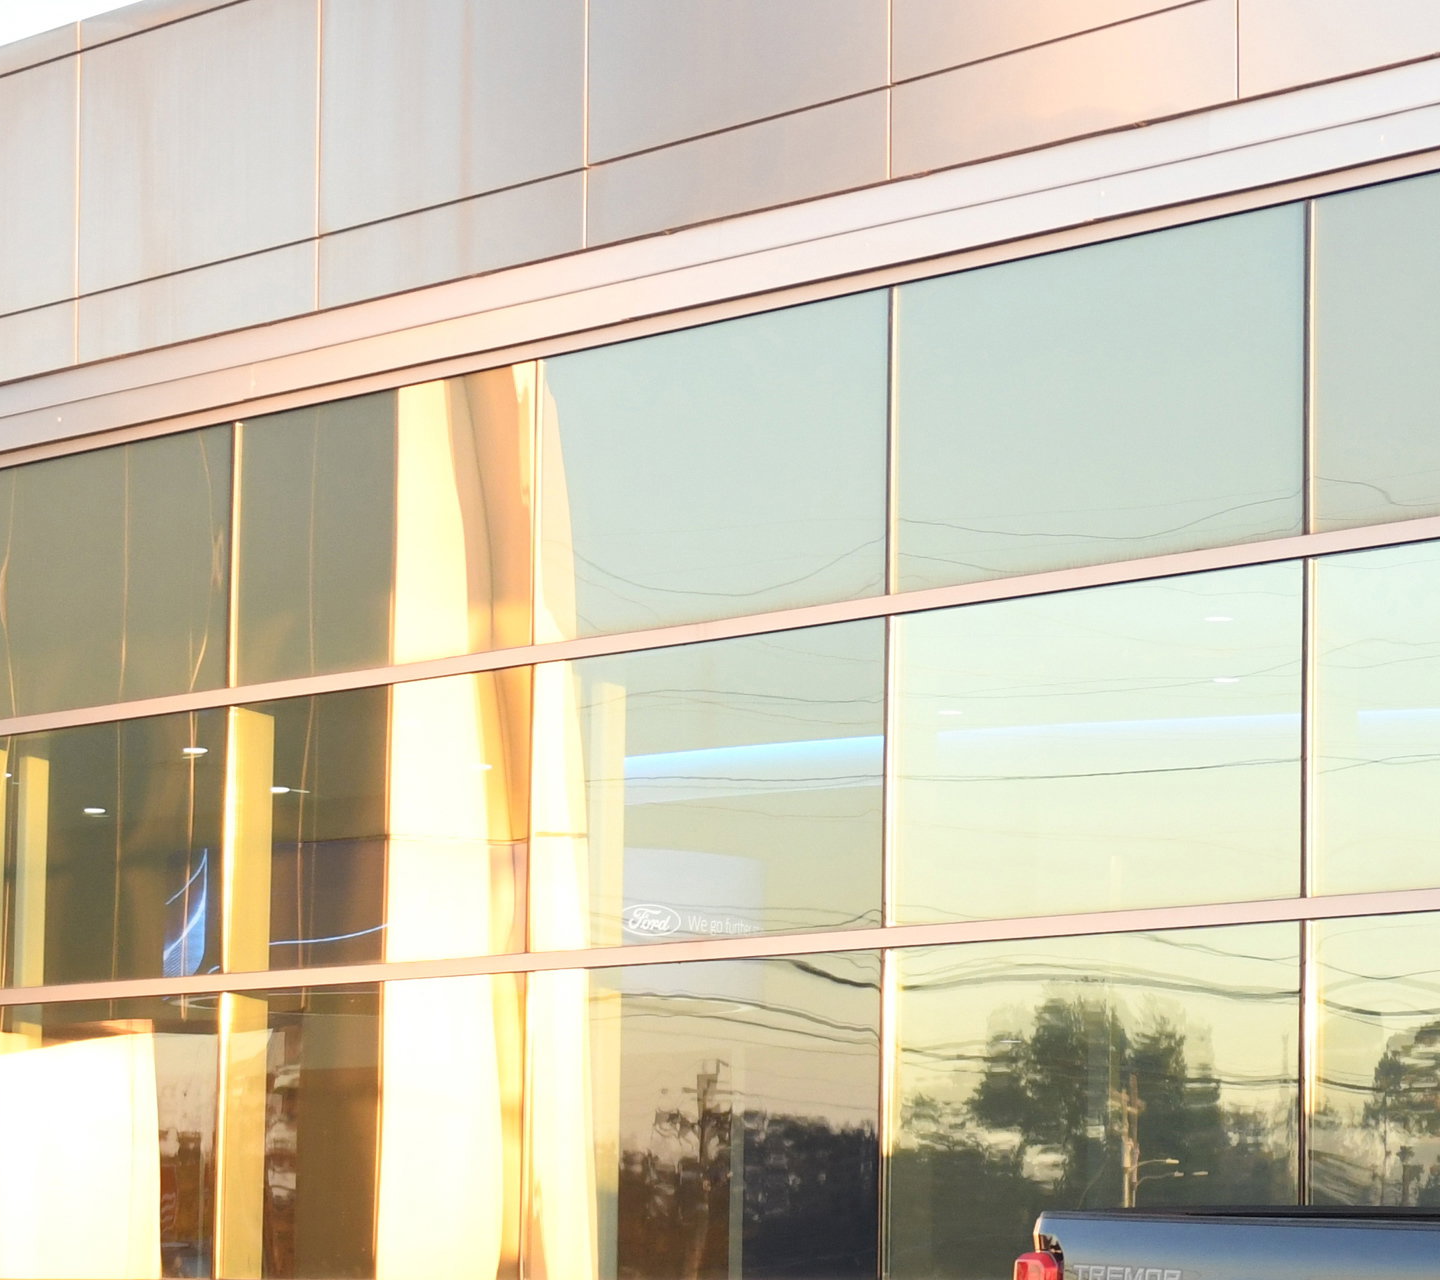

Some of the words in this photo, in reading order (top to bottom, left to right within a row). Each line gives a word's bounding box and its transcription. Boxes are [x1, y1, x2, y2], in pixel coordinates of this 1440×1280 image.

[628, 908, 672, 931] Ford
[688, 915, 708, 932] We
[710, 920, 723, 936] go
